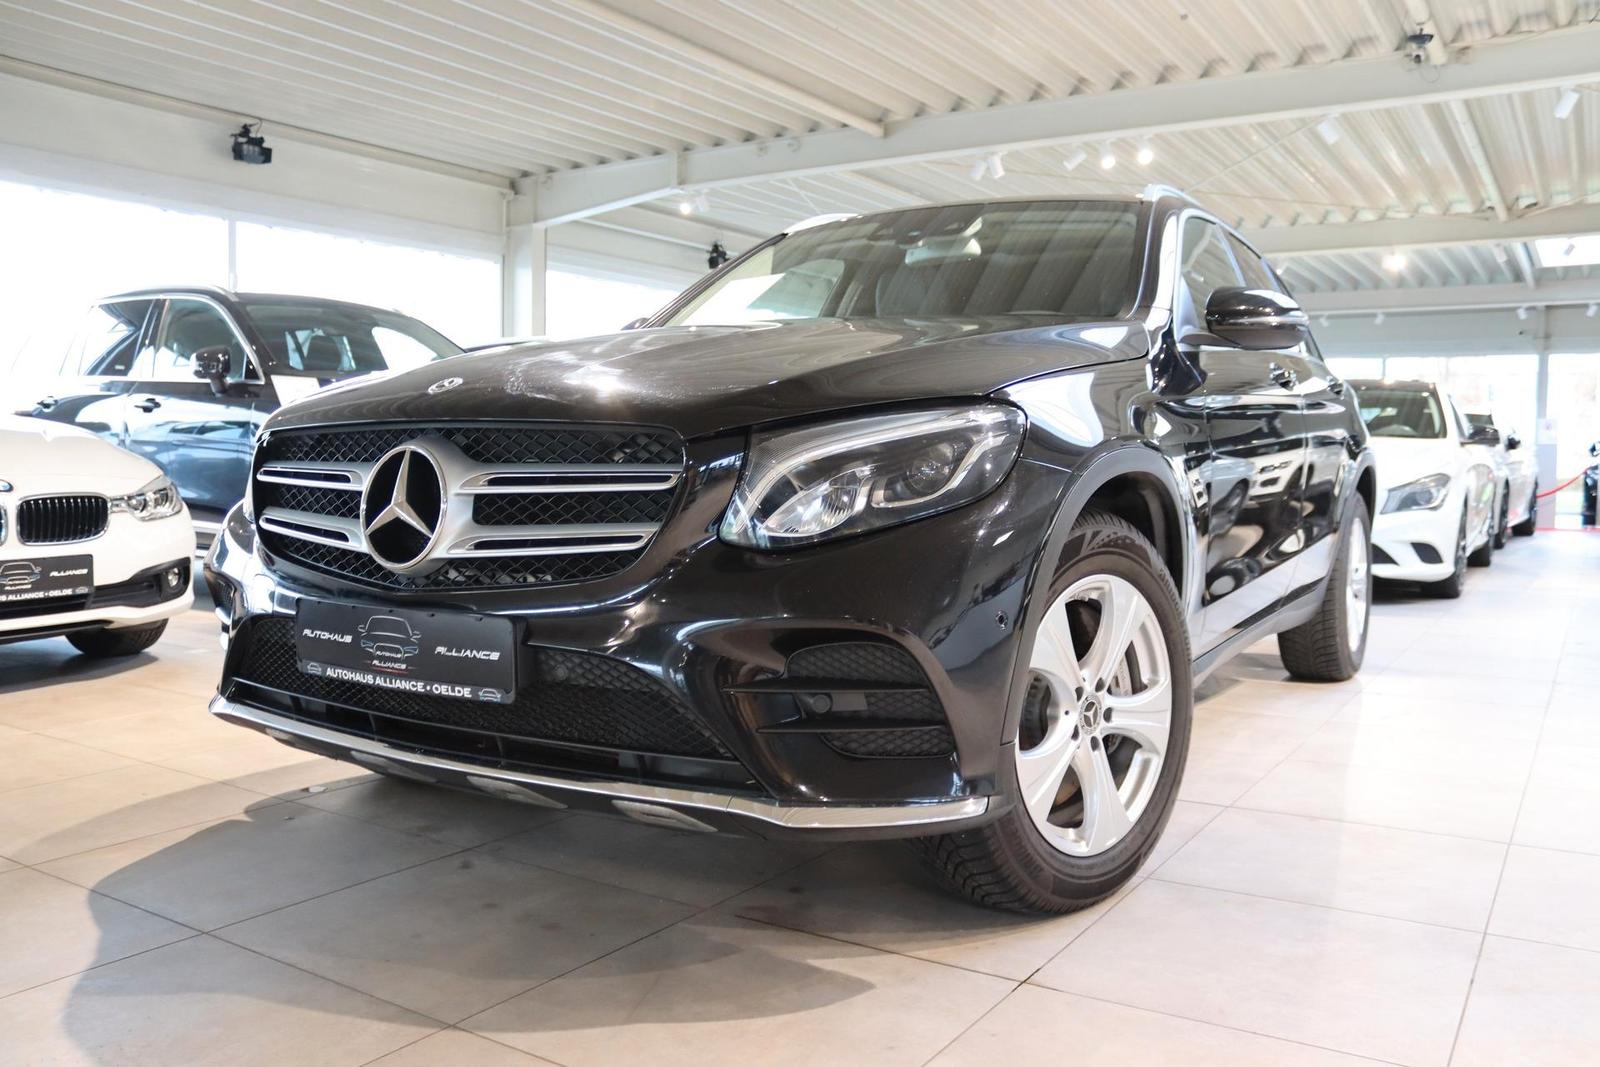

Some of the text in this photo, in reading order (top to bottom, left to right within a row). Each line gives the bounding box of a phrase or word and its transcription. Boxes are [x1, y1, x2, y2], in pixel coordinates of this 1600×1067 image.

[8, 591, 44, 600] ALLIANCE
[48, 588, 73, 597] OELDE
[302, 628, 353, 644] AUTOHAUS
[434, 646, 501, 661] ALLIANCE
[372, 659, 407, 670] ALLIANCE
[326, 667, 473, 698] AUTOHAUS ALLIANCE OELDE
